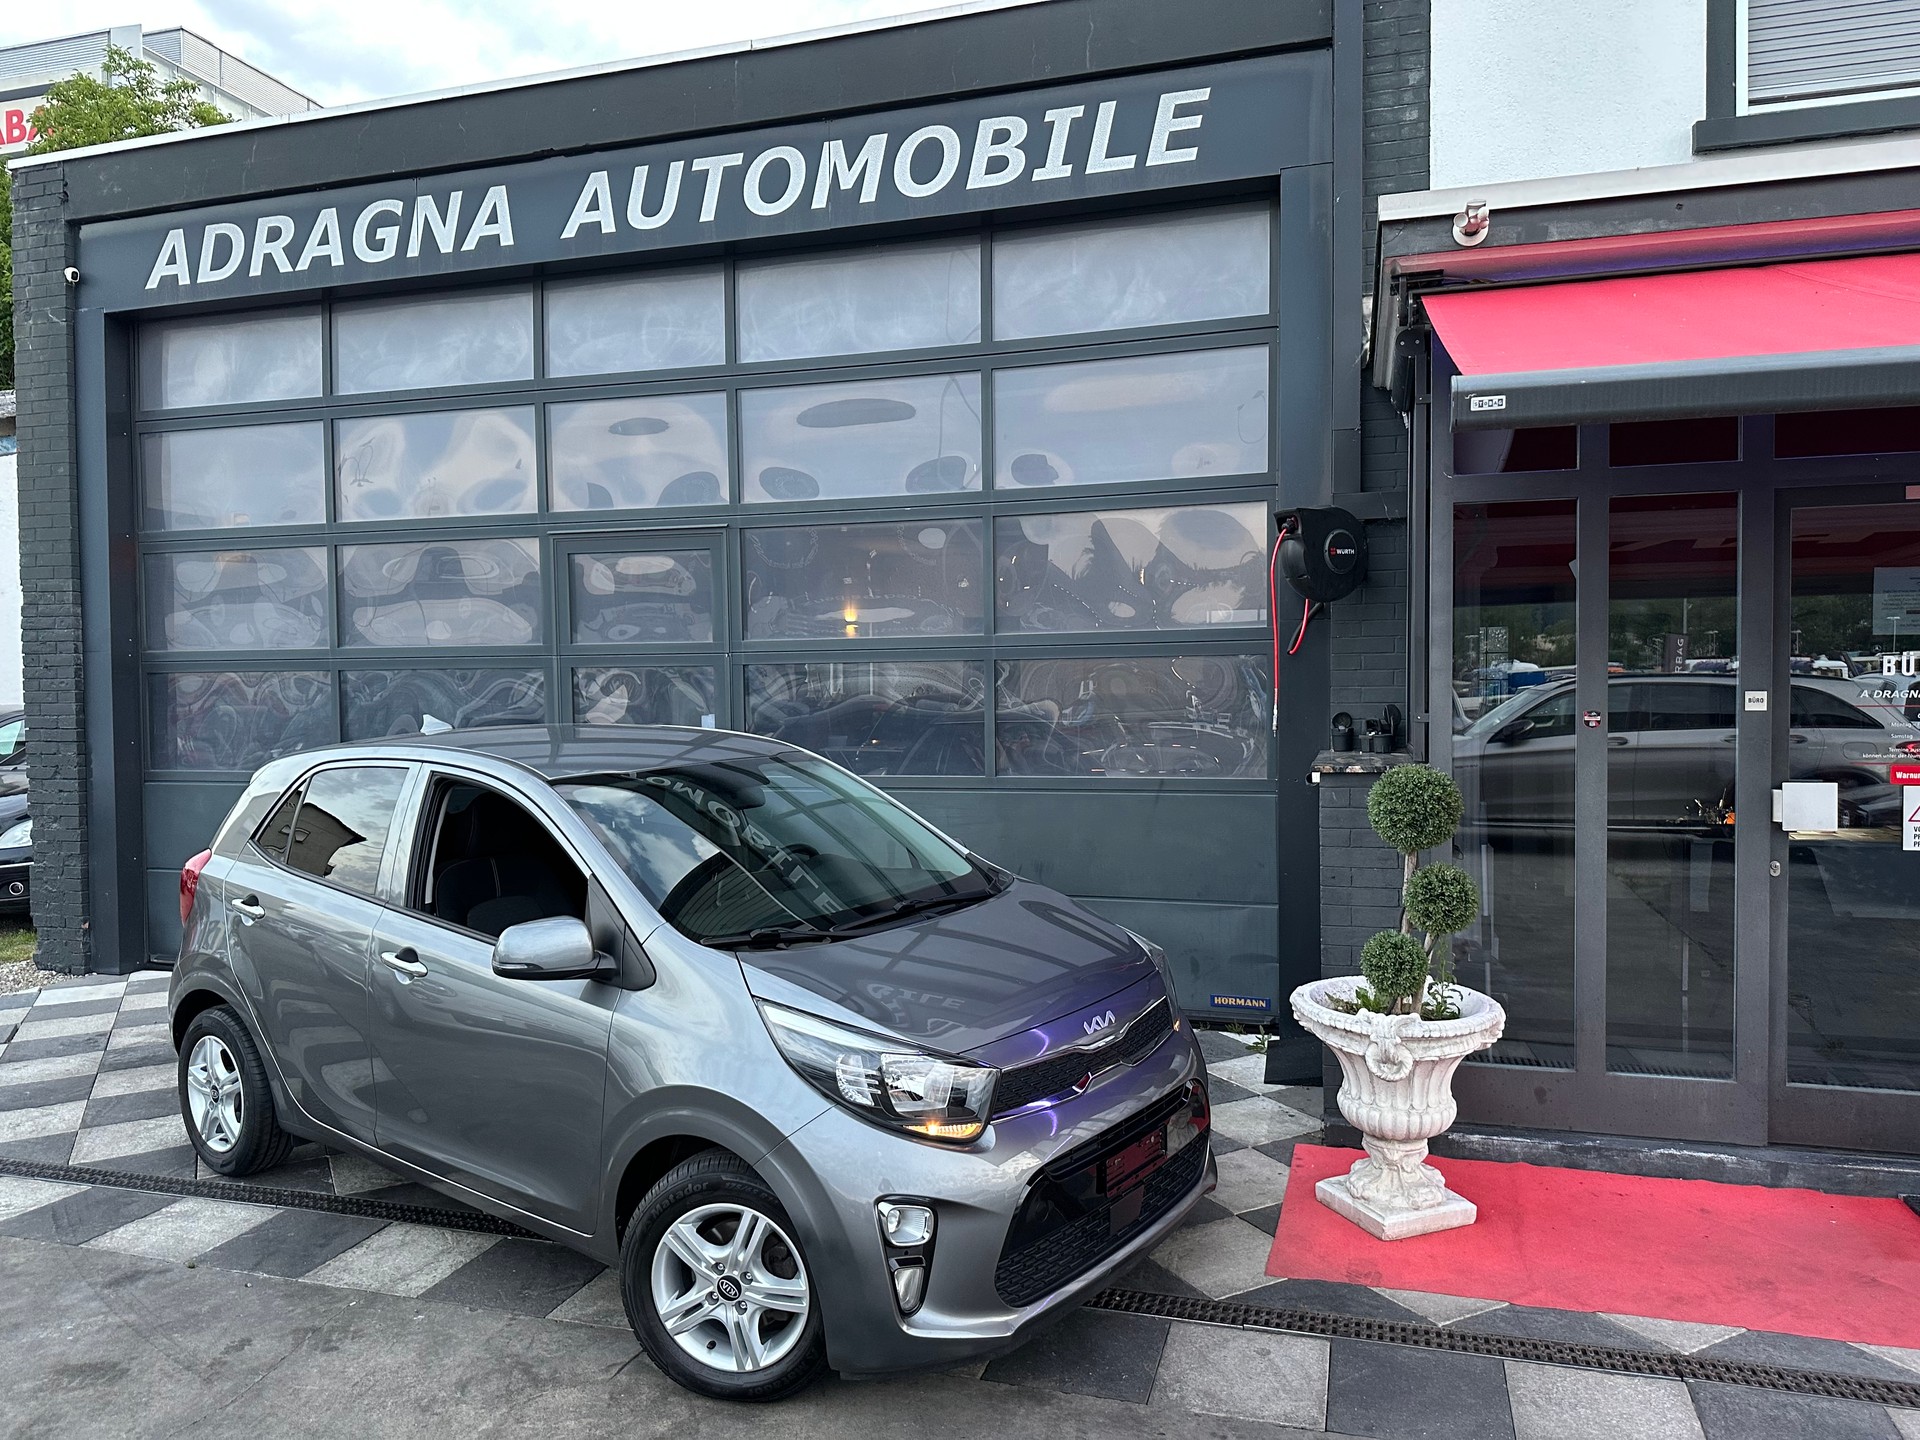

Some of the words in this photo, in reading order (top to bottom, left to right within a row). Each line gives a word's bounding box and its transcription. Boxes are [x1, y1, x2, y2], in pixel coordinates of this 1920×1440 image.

[145, 185, 515, 290] ADRAGNA
[560, 87, 1212, 239] AUTOMOBILE
[1473, 398, 1504, 409] STOBAG
[1747, 696, 1765, 704] BÜRO
[1083, 1010, 1116, 1035] KIA
[651, 1181, 709, 1219] Matador
